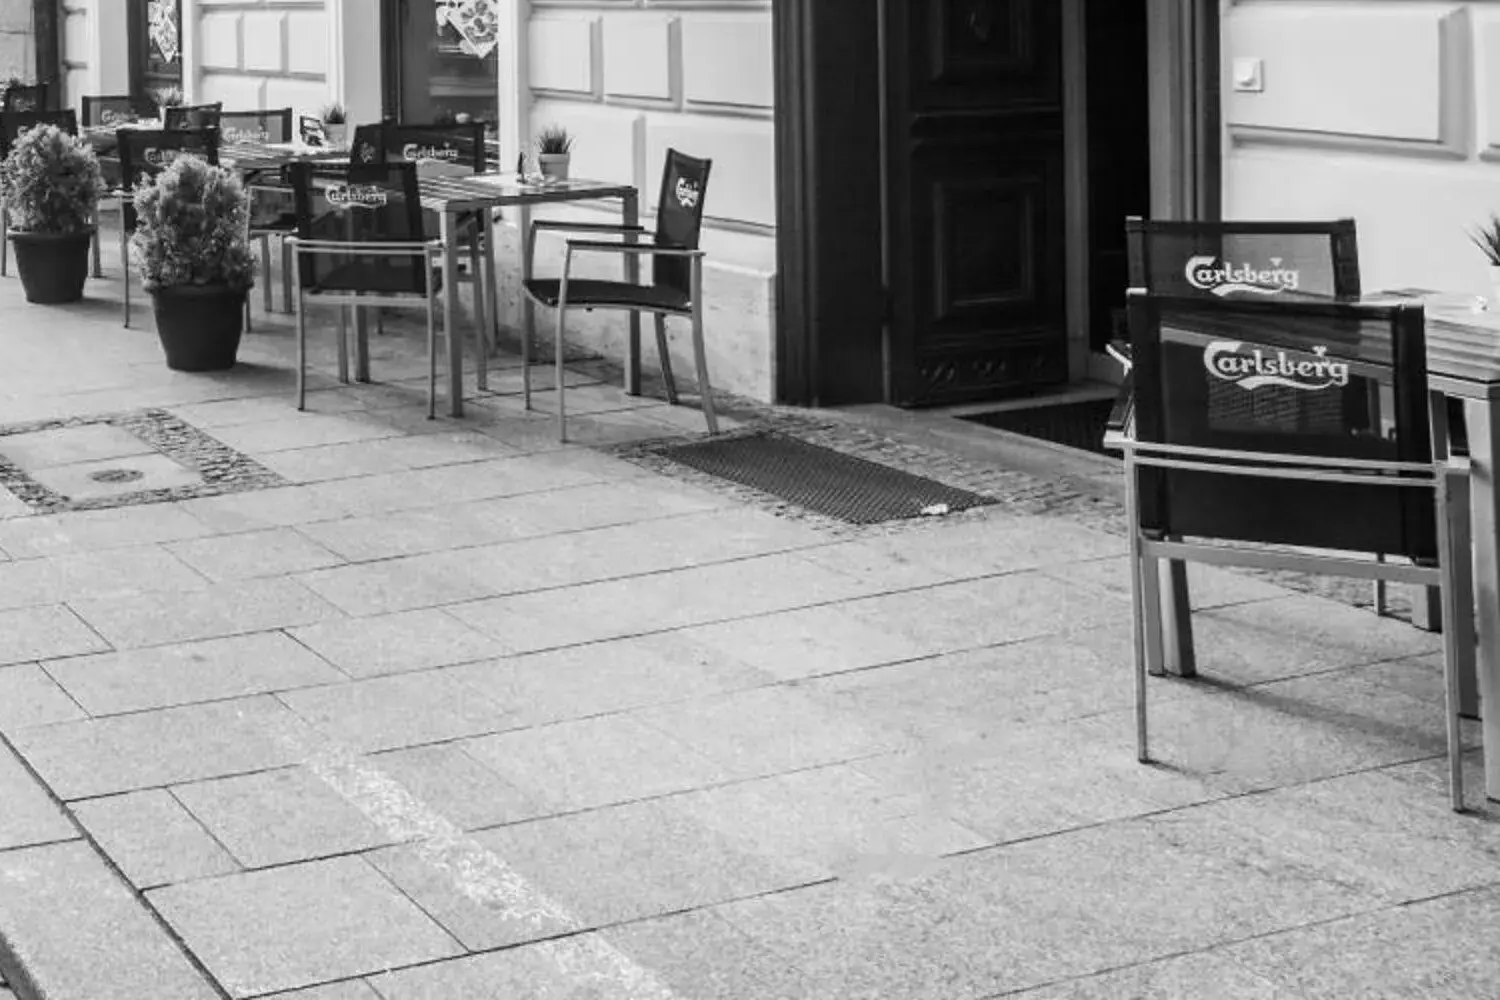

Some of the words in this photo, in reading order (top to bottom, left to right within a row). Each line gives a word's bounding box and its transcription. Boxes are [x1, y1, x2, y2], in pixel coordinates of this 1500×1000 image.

[325, 183, 387, 208] Carlsberg
[1185, 256, 1300, 293] Carlsberg
[1203, 341, 1349, 389] Carlsberg
